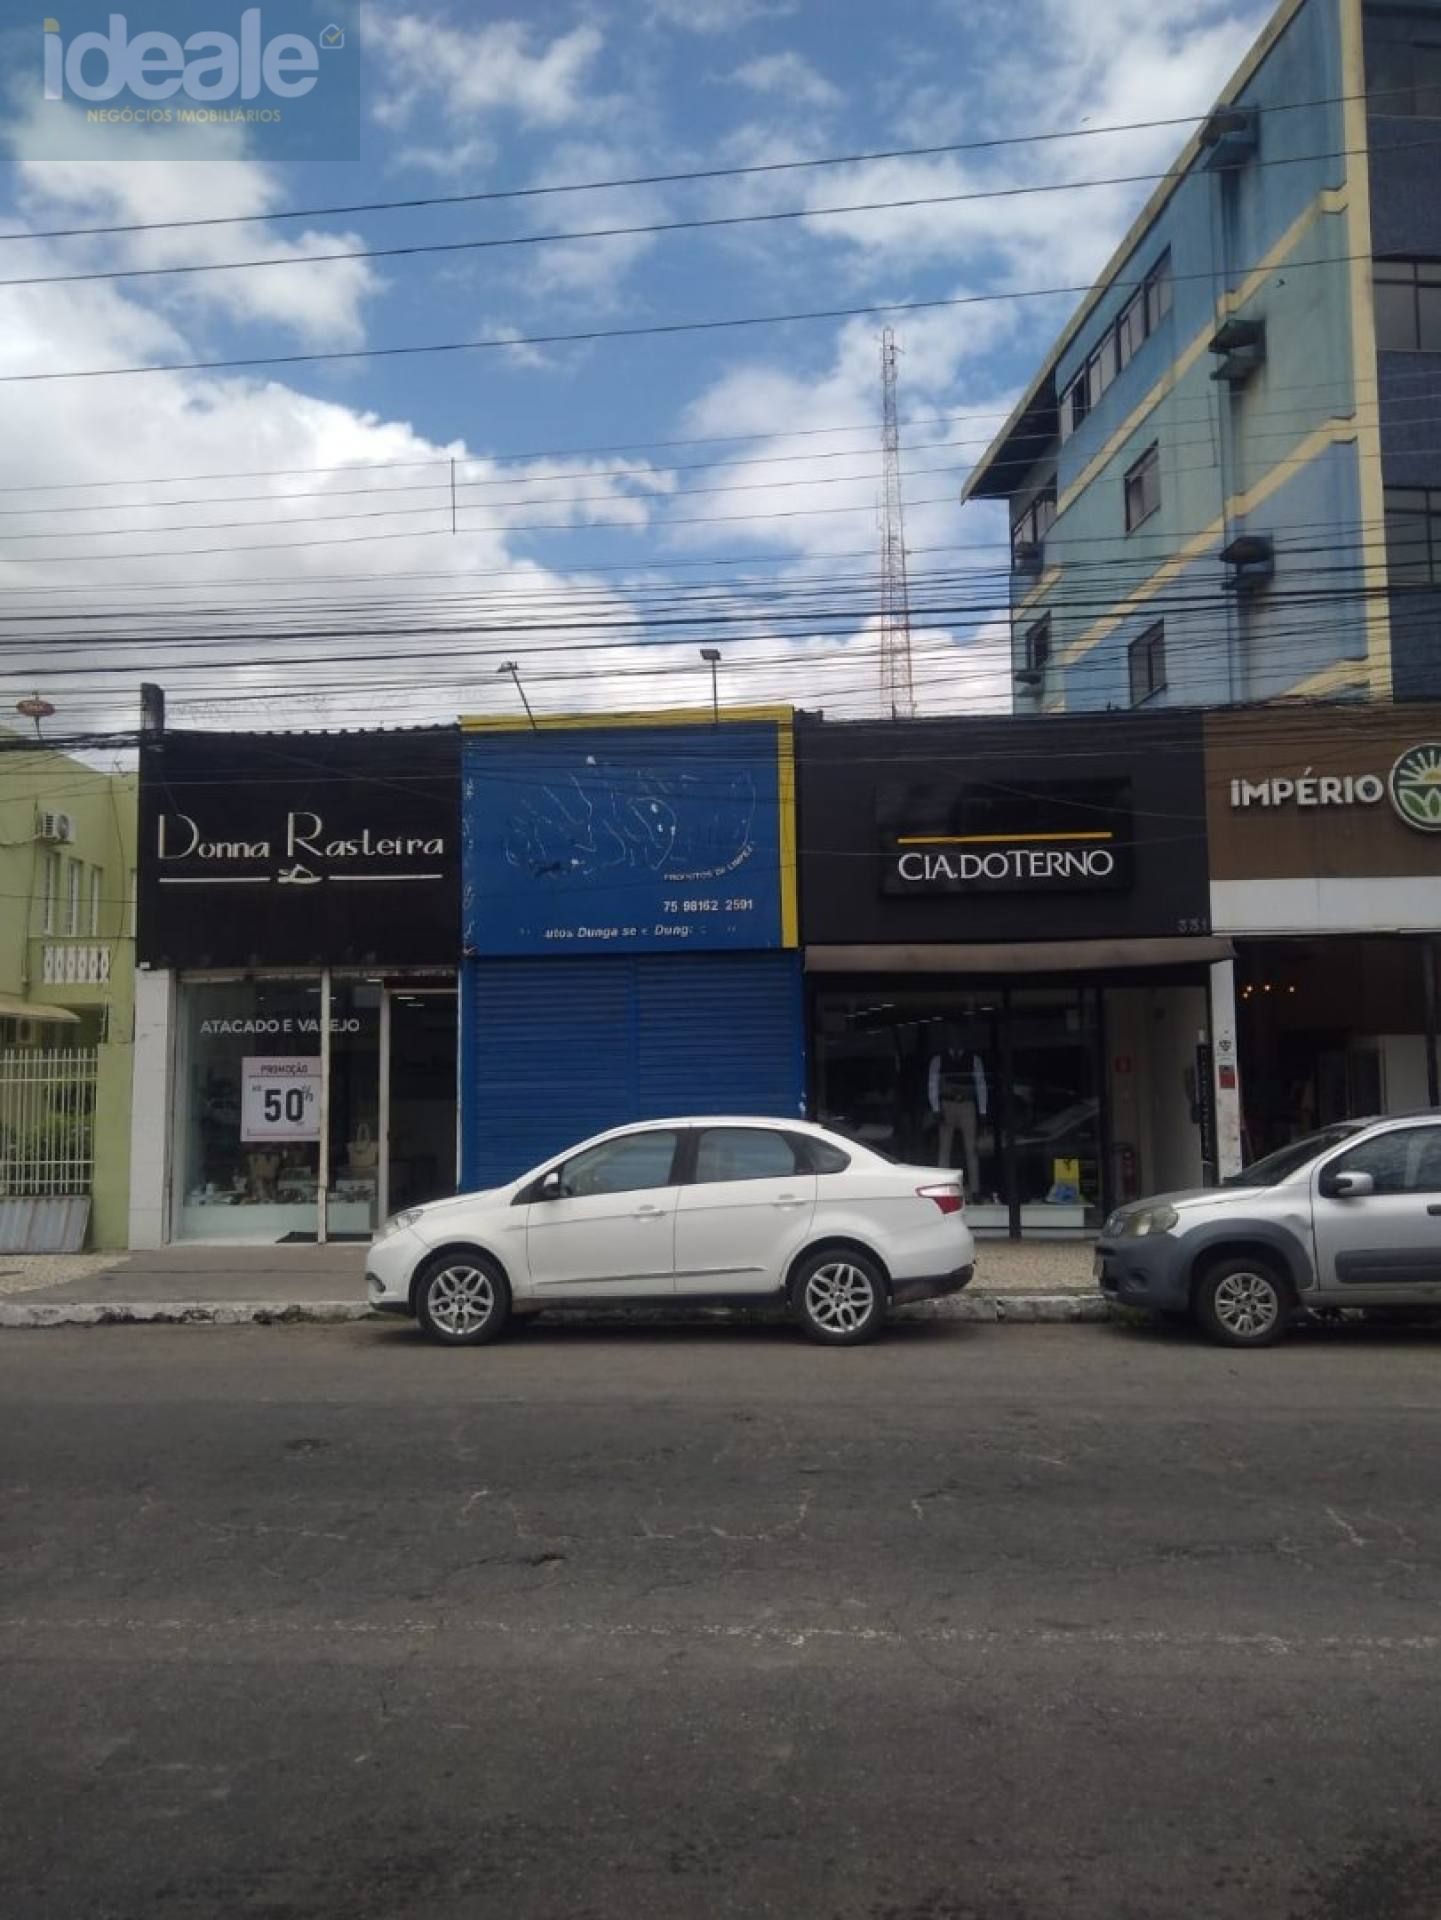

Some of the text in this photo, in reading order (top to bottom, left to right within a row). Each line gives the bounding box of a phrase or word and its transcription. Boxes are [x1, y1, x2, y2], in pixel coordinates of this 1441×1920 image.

[1230, 766, 1385, 807] IMPÉRIO
[157, 811, 444, 860] Donna Rasteira
[663, 900, 678, 913] 75
[200, 1017, 361, 1033] ATACADO E VAEJO
[260, 1061, 309, 1075] PROMOÇÃO
